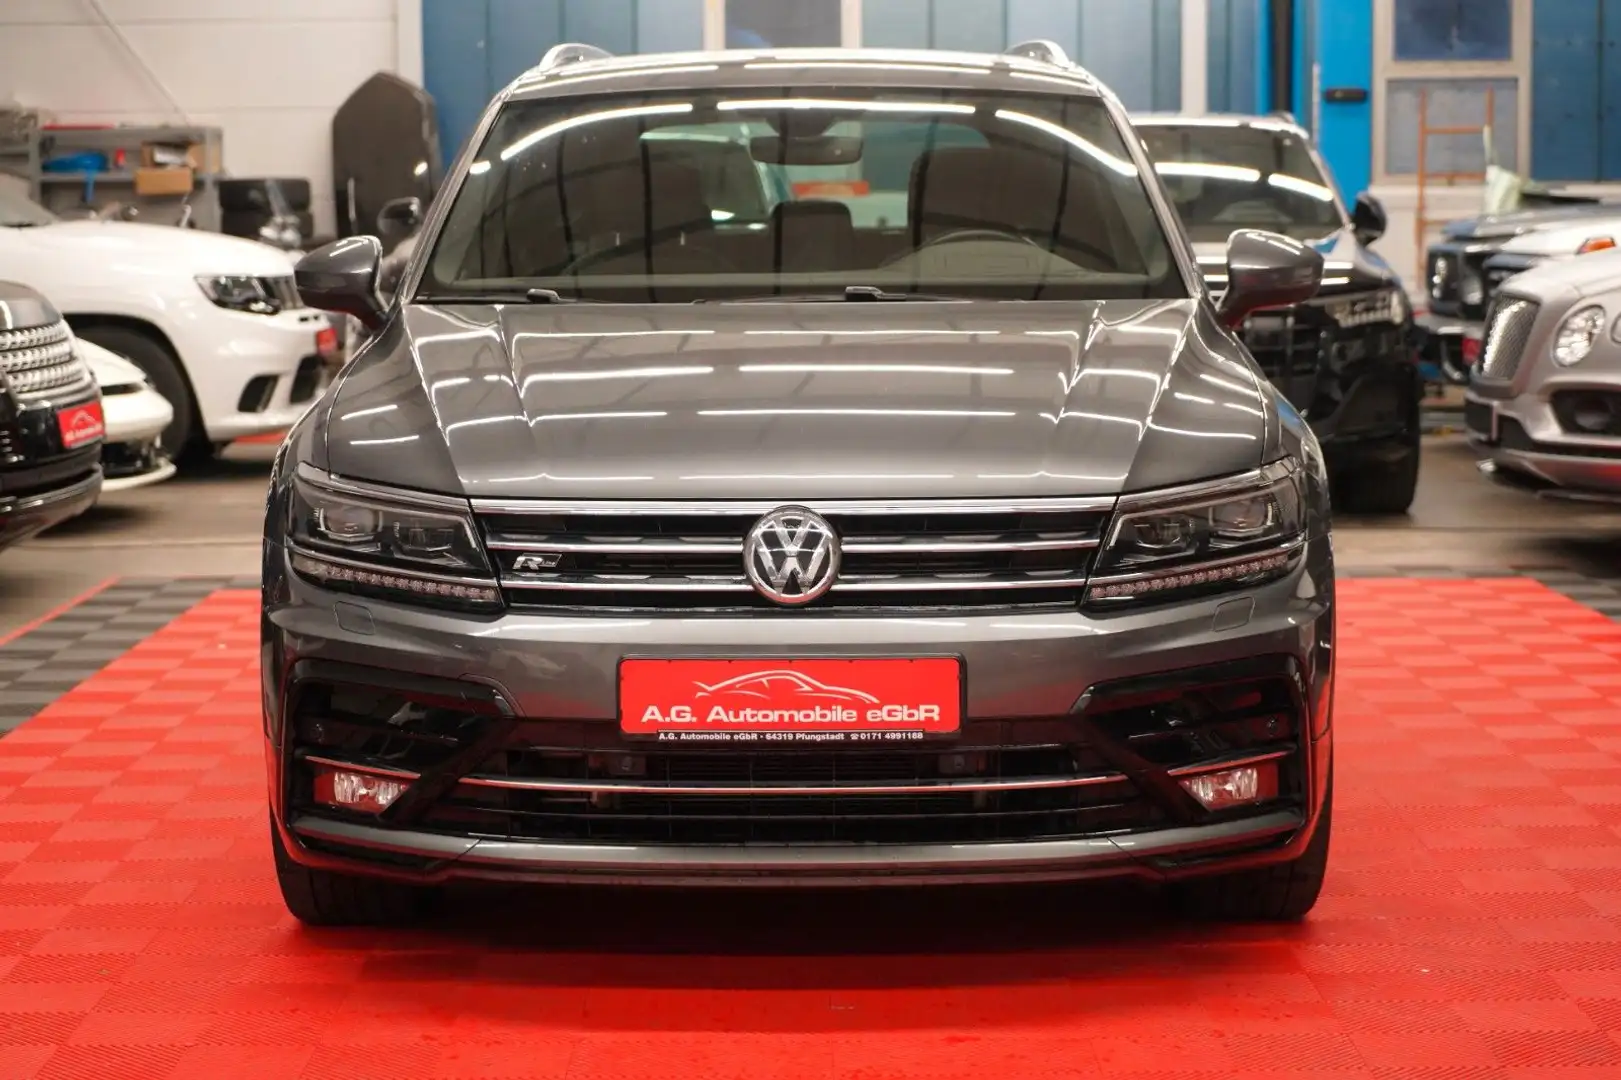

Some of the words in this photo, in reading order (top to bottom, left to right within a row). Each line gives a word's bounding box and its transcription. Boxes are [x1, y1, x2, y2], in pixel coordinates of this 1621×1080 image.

[640, 705, 698, 723] A.G.
[706, 705, 857, 723] Automobile
[866, 704, 940, 722] eGbR
[658, 732, 678, 741] A.G.
[680, 732, 731, 741] Automobile
[733, 732, 758, 741] eGbR
[765, 732, 793, 741] 64319
[795, 732, 845, 742] Pfungstadt
[860, 732, 882, 741] 0171
[884, 731, 924, 740] 4991188
